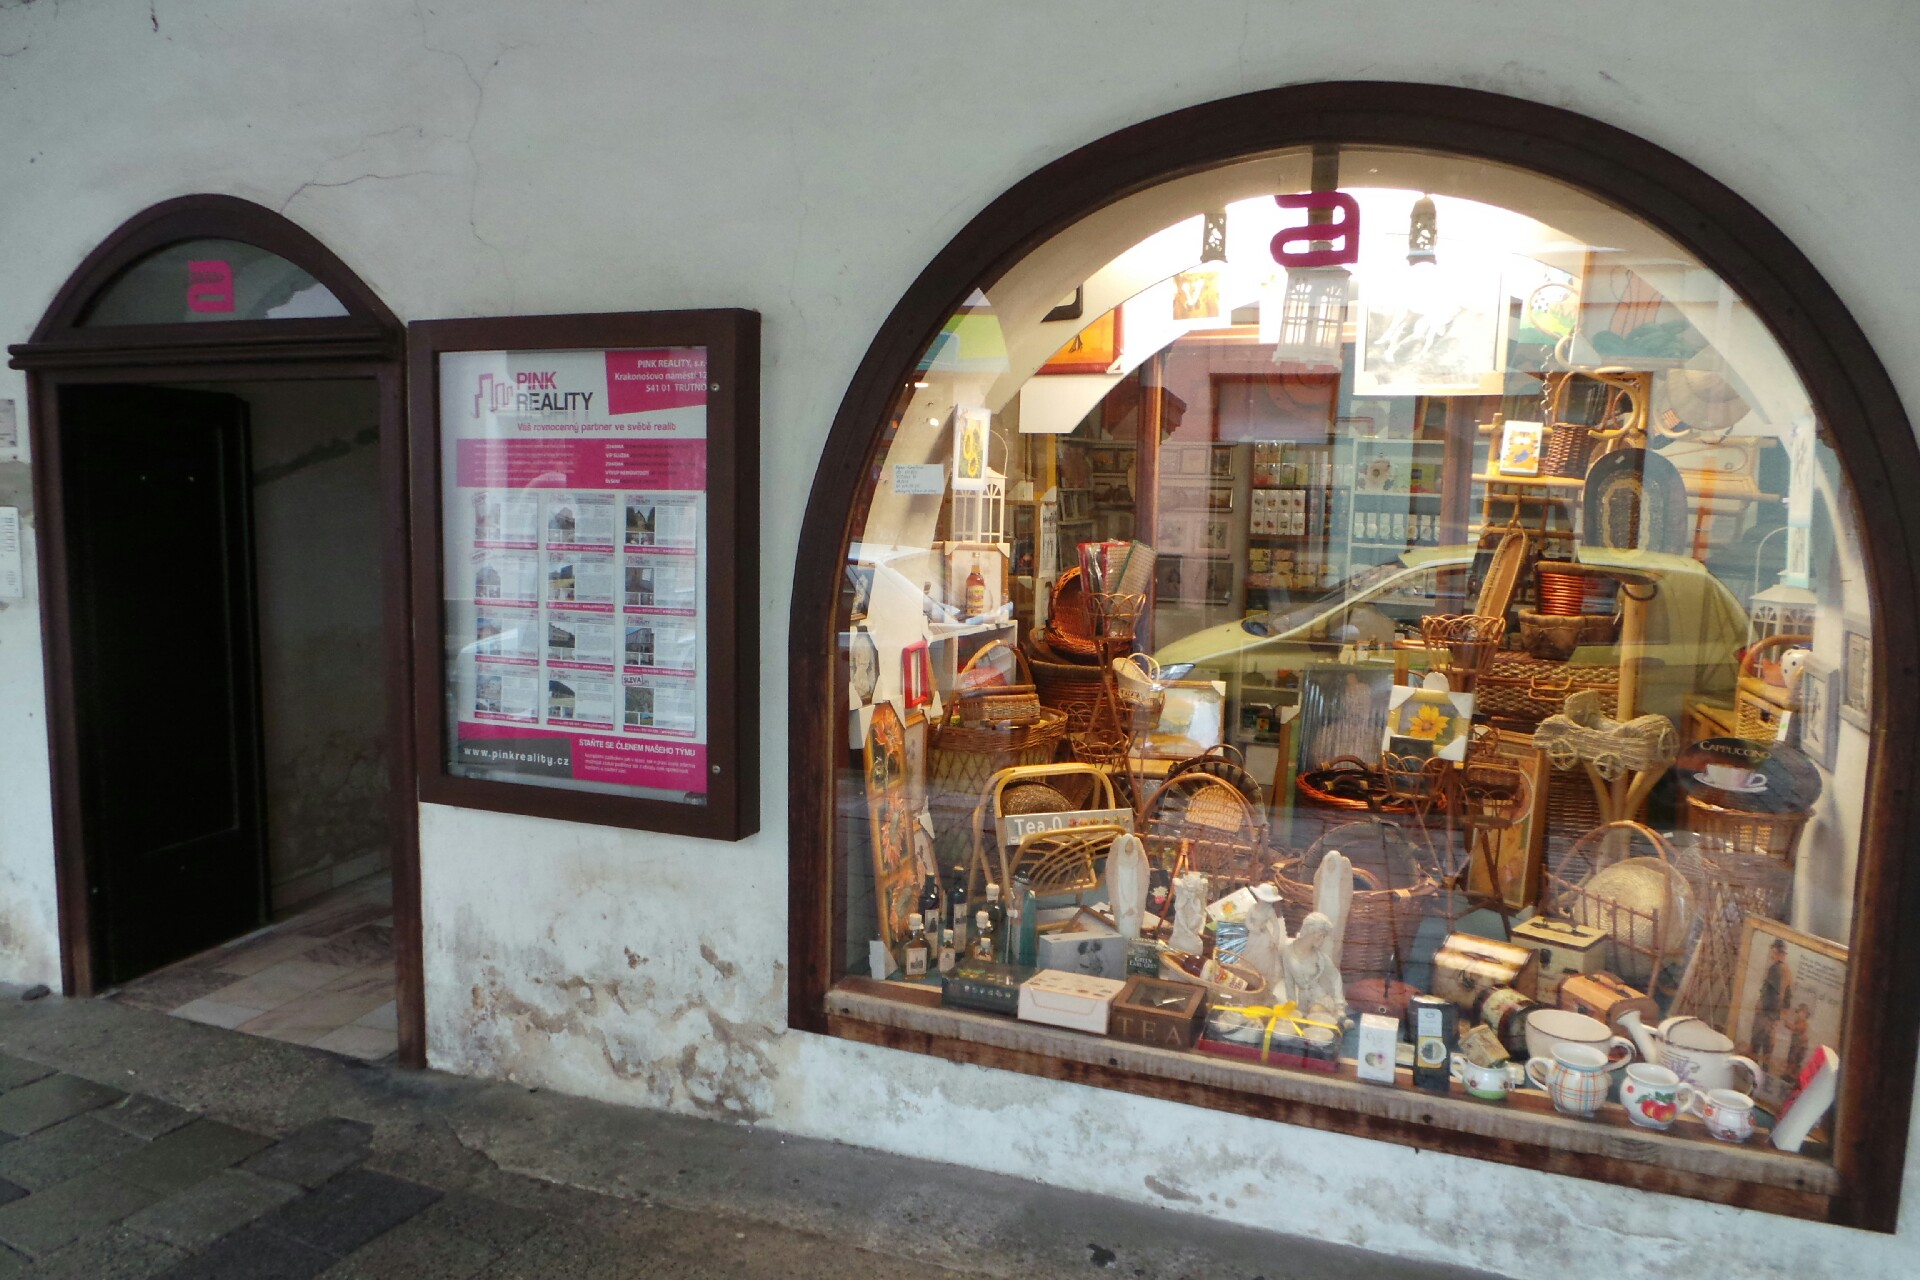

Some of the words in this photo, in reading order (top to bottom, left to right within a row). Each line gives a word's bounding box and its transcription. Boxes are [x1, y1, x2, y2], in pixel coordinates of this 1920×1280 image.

[637, 359, 657, 369] PINK
[658, 359, 693, 369] REALITY,
[516, 371, 558, 390] PINK
[646, 384, 660, 393] 541
[661, 384, 671, 392] 01
[516, 392, 594, 411] REALITY
[533, 422, 580, 433] rovnocenný
[581, 422, 612, 433] partner
[627, 422, 651, 431] světě
[653, 421, 676, 431] realit
[463, 747, 570, 767] www.pinkreality.cz
[579, 738, 604, 749] STAŇTE
[605, 741, 615, 750] SE
[616, 740, 644, 752] ČLENEM
[645, 743, 674, 755] NAŠEHO
[675, 745, 696, 757] TÝMU
[1116, 1016, 1183, 1046] TEA
